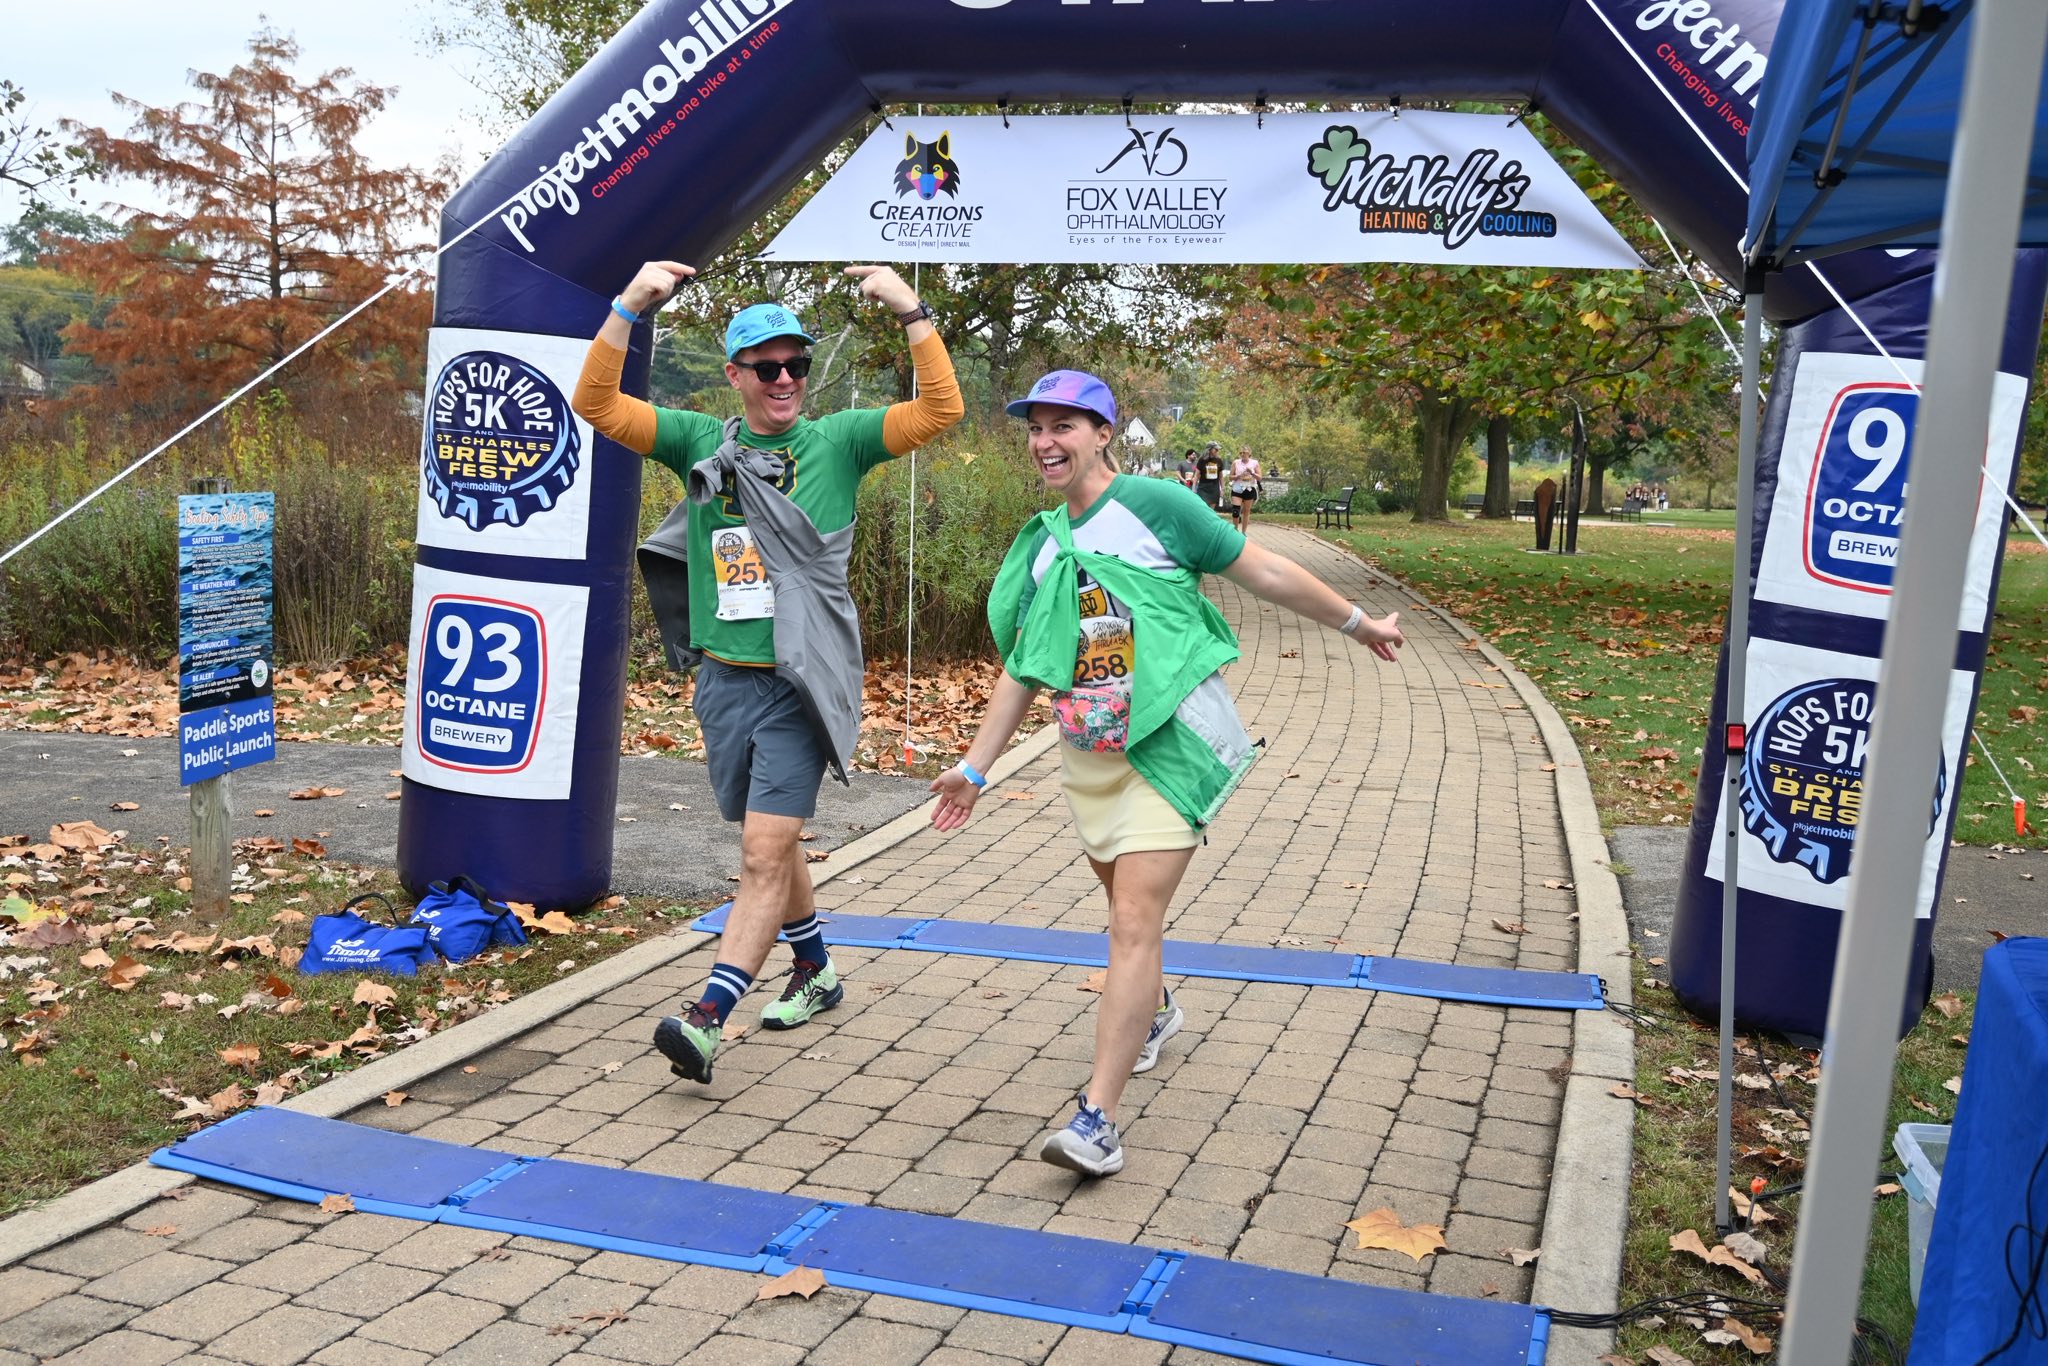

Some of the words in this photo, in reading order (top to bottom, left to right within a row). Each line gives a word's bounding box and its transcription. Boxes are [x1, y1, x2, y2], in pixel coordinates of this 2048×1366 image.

[1656, 43, 1720, 109] Changing
[1717, 102, 1750, 137] lives
[591, 144, 650, 199] Changing
[646, 118, 676, 148] lives
[675, 96, 700, 121] one
[697, 70, 727, 99] bike
[726, 56, 742, 74] at
[741, 48, 752, 60] a
[749, 20, 780, 50] time
[869, 200, 984, 221] CREATIONS
[1067, 187, 1118, 211] FOX
[1125, 187, 1229, 211] VALLEY
[1326, 152, 1528, 248] McNally's
[880, 222, 974, 242] CREATIVE
[1067, 214, 1226, 230] OPHTHALMOLOGY
[1363, 211, 1428, 230] HEATING
[1432, 213, 1445, 231] &
[1482, 213, 1554, 234] COOLING
[1069, 235, 1096, 246] Eyes
[1103, 235, 1115, 244] of
[1123, 235, 1141, 244] the
[1148, 235, 1168, 244] Fox
[1174, 235, 1224, 246] Eyewear
[436, 370, 467, 424] HOPS
[467, 362, 511, 392] FOR
[507, 376, 554, 432] HOPE
[465, 392, 508, 430] 5K
[436, 433, 456, 443] ST.
[461, 436, 552, 452] CHARLES
[1847, 407, 1912, 498] 9
[438, 445, 542, 468] BREW
[448, 462, 519, 481] FEST
[184, 507, 219, 530] Boating
[220, 504, 248, 528] Safety
[249, 505, 269, 530] Tips
[192, 537, 210, 545] SAFETY
[211, 536, 225, 544] FIRST
[1837, 539, 1898, 558] BREW
[192, 583, 199, 591] BE
[199, 580, 237, 590] WEATHER-WISE
[192, 639, 229, 651] COMMUNICATE
[436, 614, 522, 693] 93
[192, 674, 199, 683] BE
[199, 672, 215, 681] ALERT
[1075, 654, 1128, 682] 258
[425, 690, 526, 721] OCTANE
[184, 718, 227, 745] Paddle
[229, 708, 270, 734] Sports
[434, 725, 506, 745] BREWERY
[1768, 697, 1830, 756] HOPS
[184, 747, 224, 771] Public
[226, 731, 272, 758] Launch
[1768, 763, 1804, 779] ST.
[1836, 768, 1861, 777] AND
[1772, 776, 1862, 807] BRE
[1790, 799, 1860, 826] FES
[322, 956, 381, 964] www.J3Timing.com
[326, 944, 381, 958] Timing
